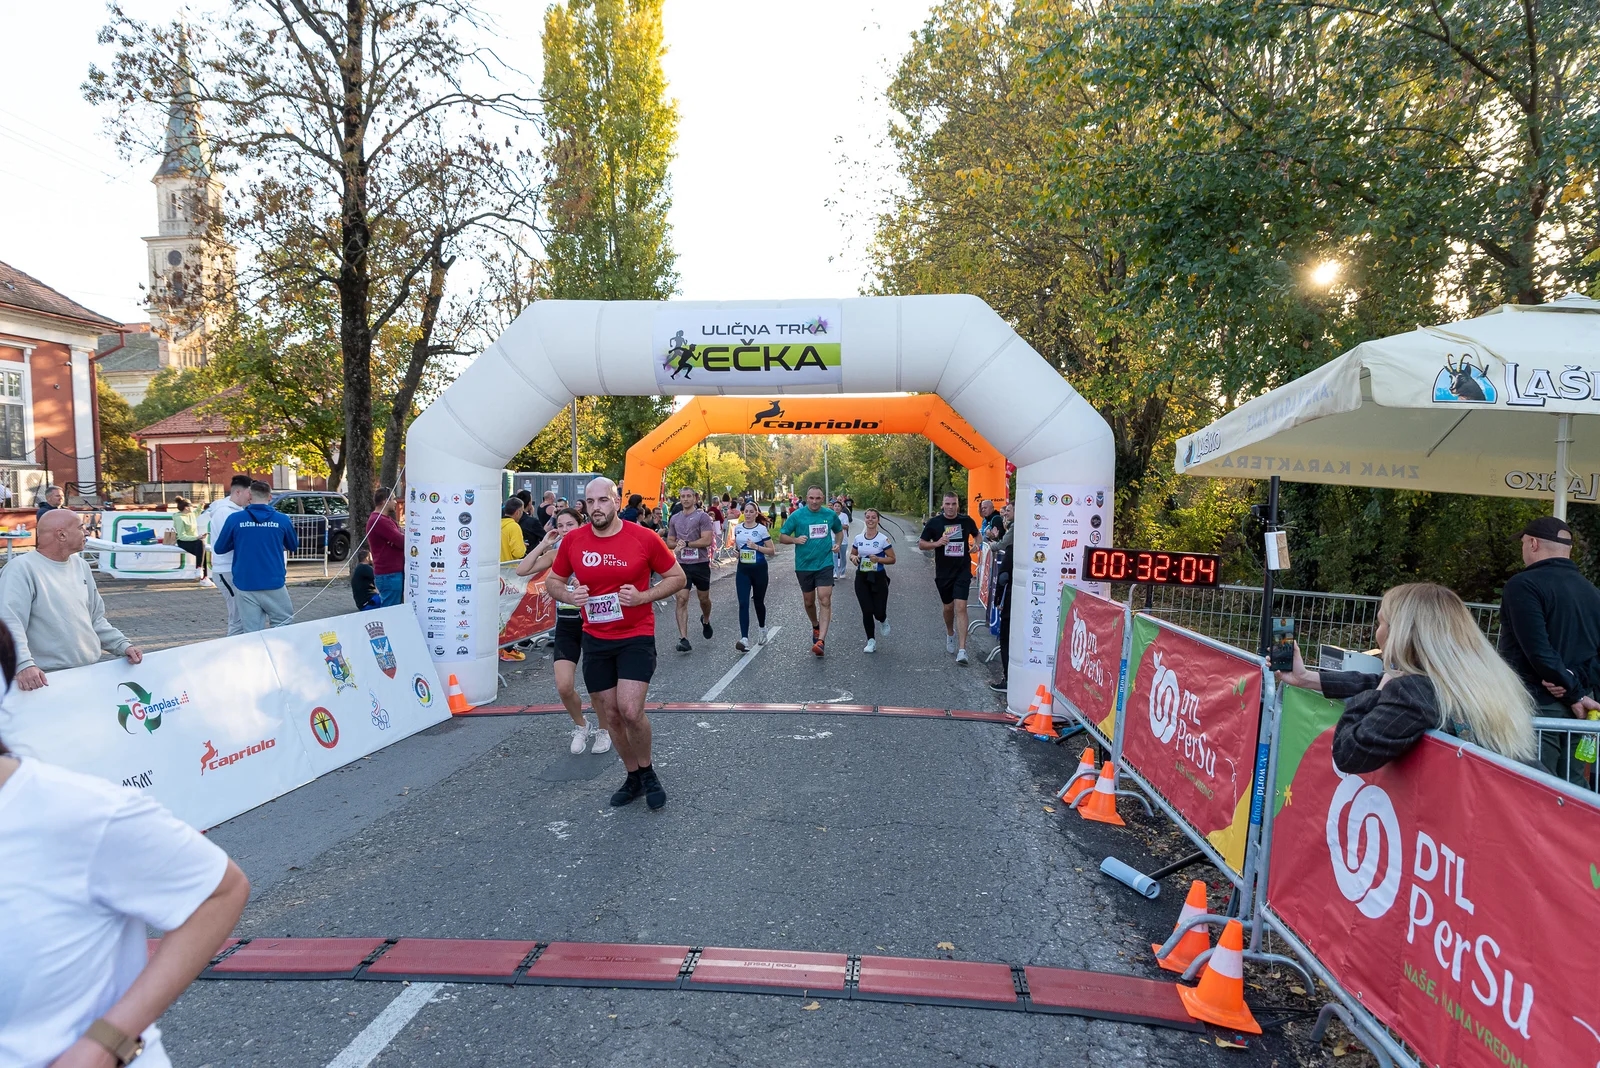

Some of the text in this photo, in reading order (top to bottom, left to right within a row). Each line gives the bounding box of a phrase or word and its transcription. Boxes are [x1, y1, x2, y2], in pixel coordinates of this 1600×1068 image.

[701, 322, 828, 336] ULIČNA TRKA
[702, 338, 828, 372] EČKA
[1502, 362, 1600, 407] LAŠ
[763, 418, 880, 431] capriolo
[1193, 429, 1221, 464] LAŠKO
[1061, 538, 1078, 550] Duel
[1091, 551, 1215, 583] 00:32:04
[589, 600, 613, 614] 2232
[1087, 631, 1098, 655] DTL
[1083, 651, 1104, 688] PerSu
[131, 696, 181, 721] Granplast
[1181, 689, 1201, 726] DTL
[208, 738, 275, 771] capriolo
[1175, 717, 1217, 779] PerSu
[1413, 830, 1474, 916] DTL
[1406, 882, 1534, 1040] PerSu
[1403, 960, 1439, 1005] NAŠE,
[1475, 1019, 1529, 1068] VREDN
